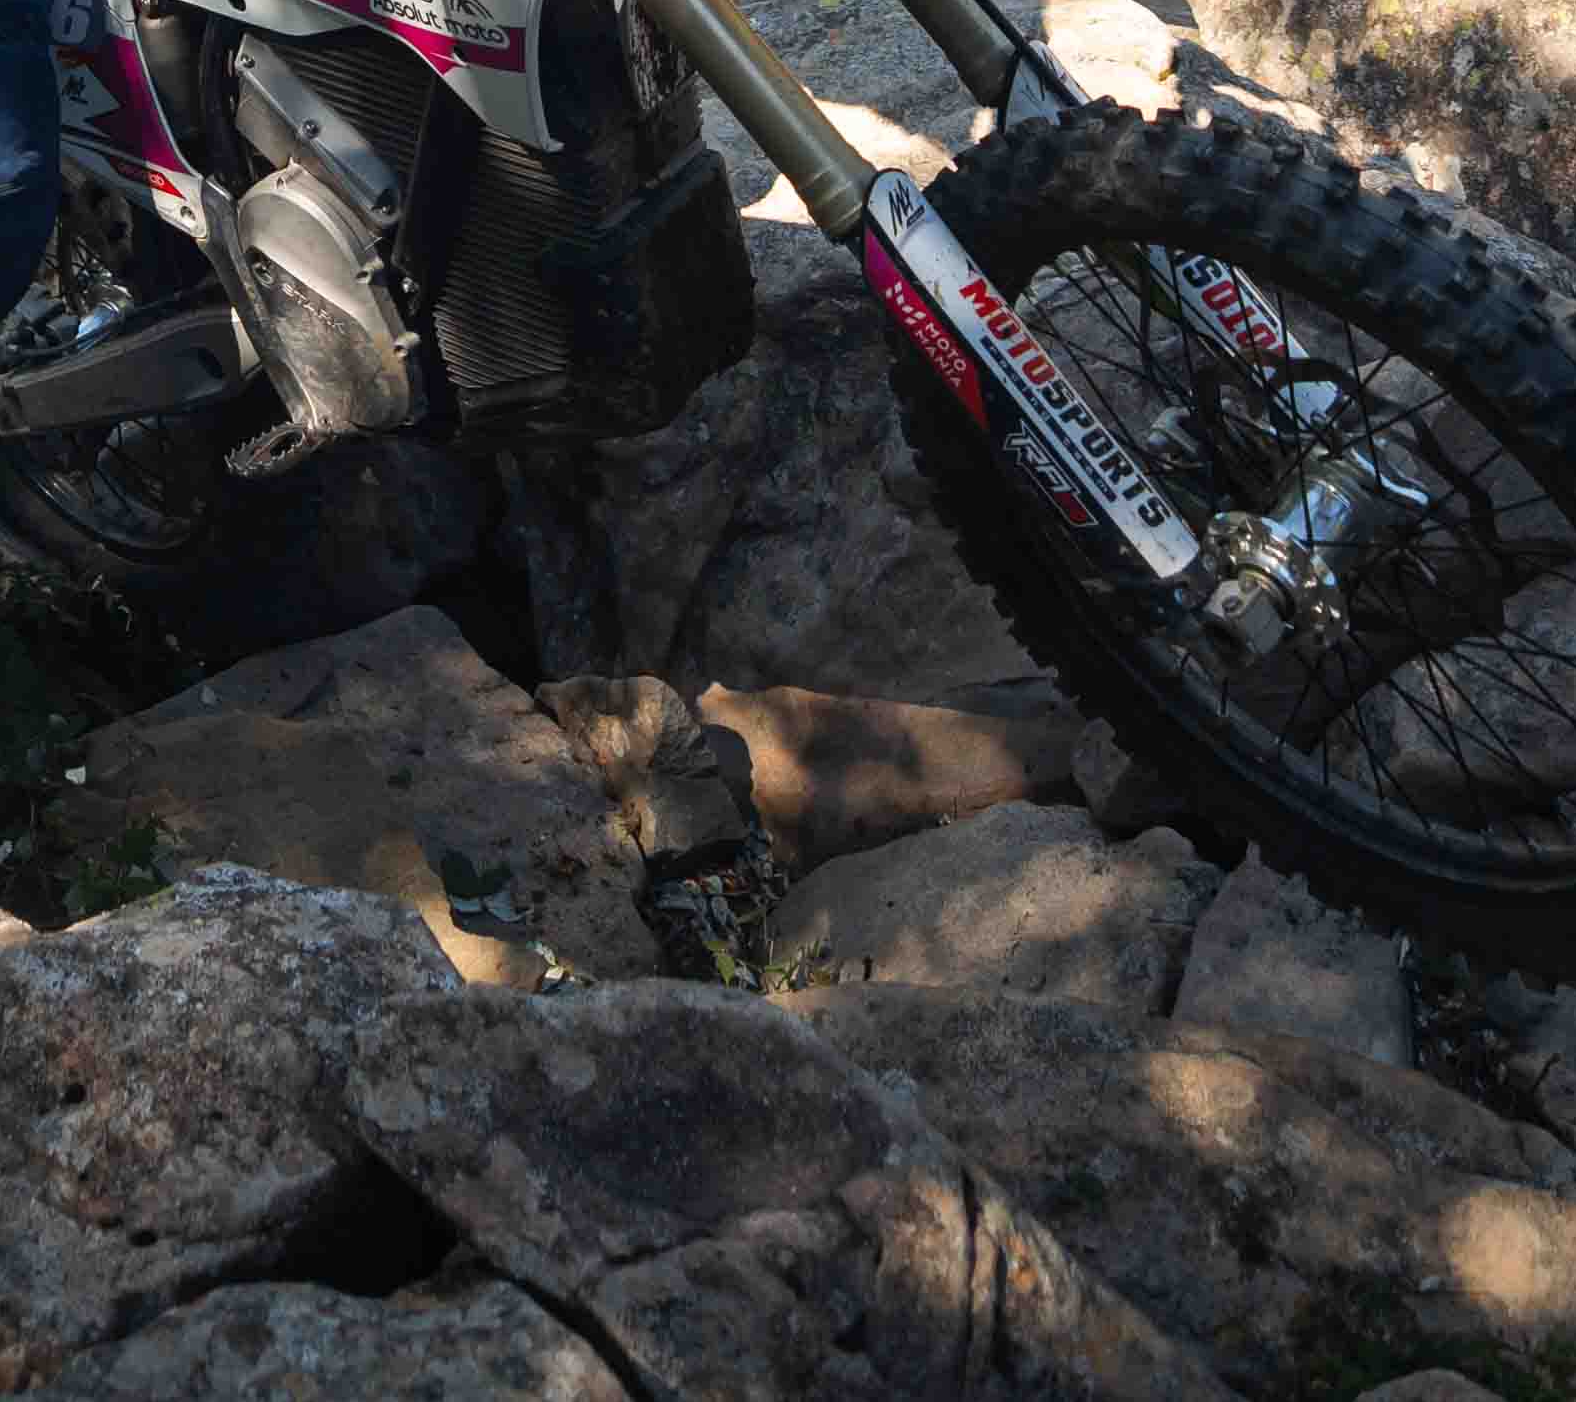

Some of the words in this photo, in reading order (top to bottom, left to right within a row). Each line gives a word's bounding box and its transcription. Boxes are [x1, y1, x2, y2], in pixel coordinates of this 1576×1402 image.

[445, 16, 505, 45] moto
[914, 328, 963, 389] MANIA
[923, 322, 968, 374] MOTO
[958, 276, 1173, 528] MOTOSPORTS
